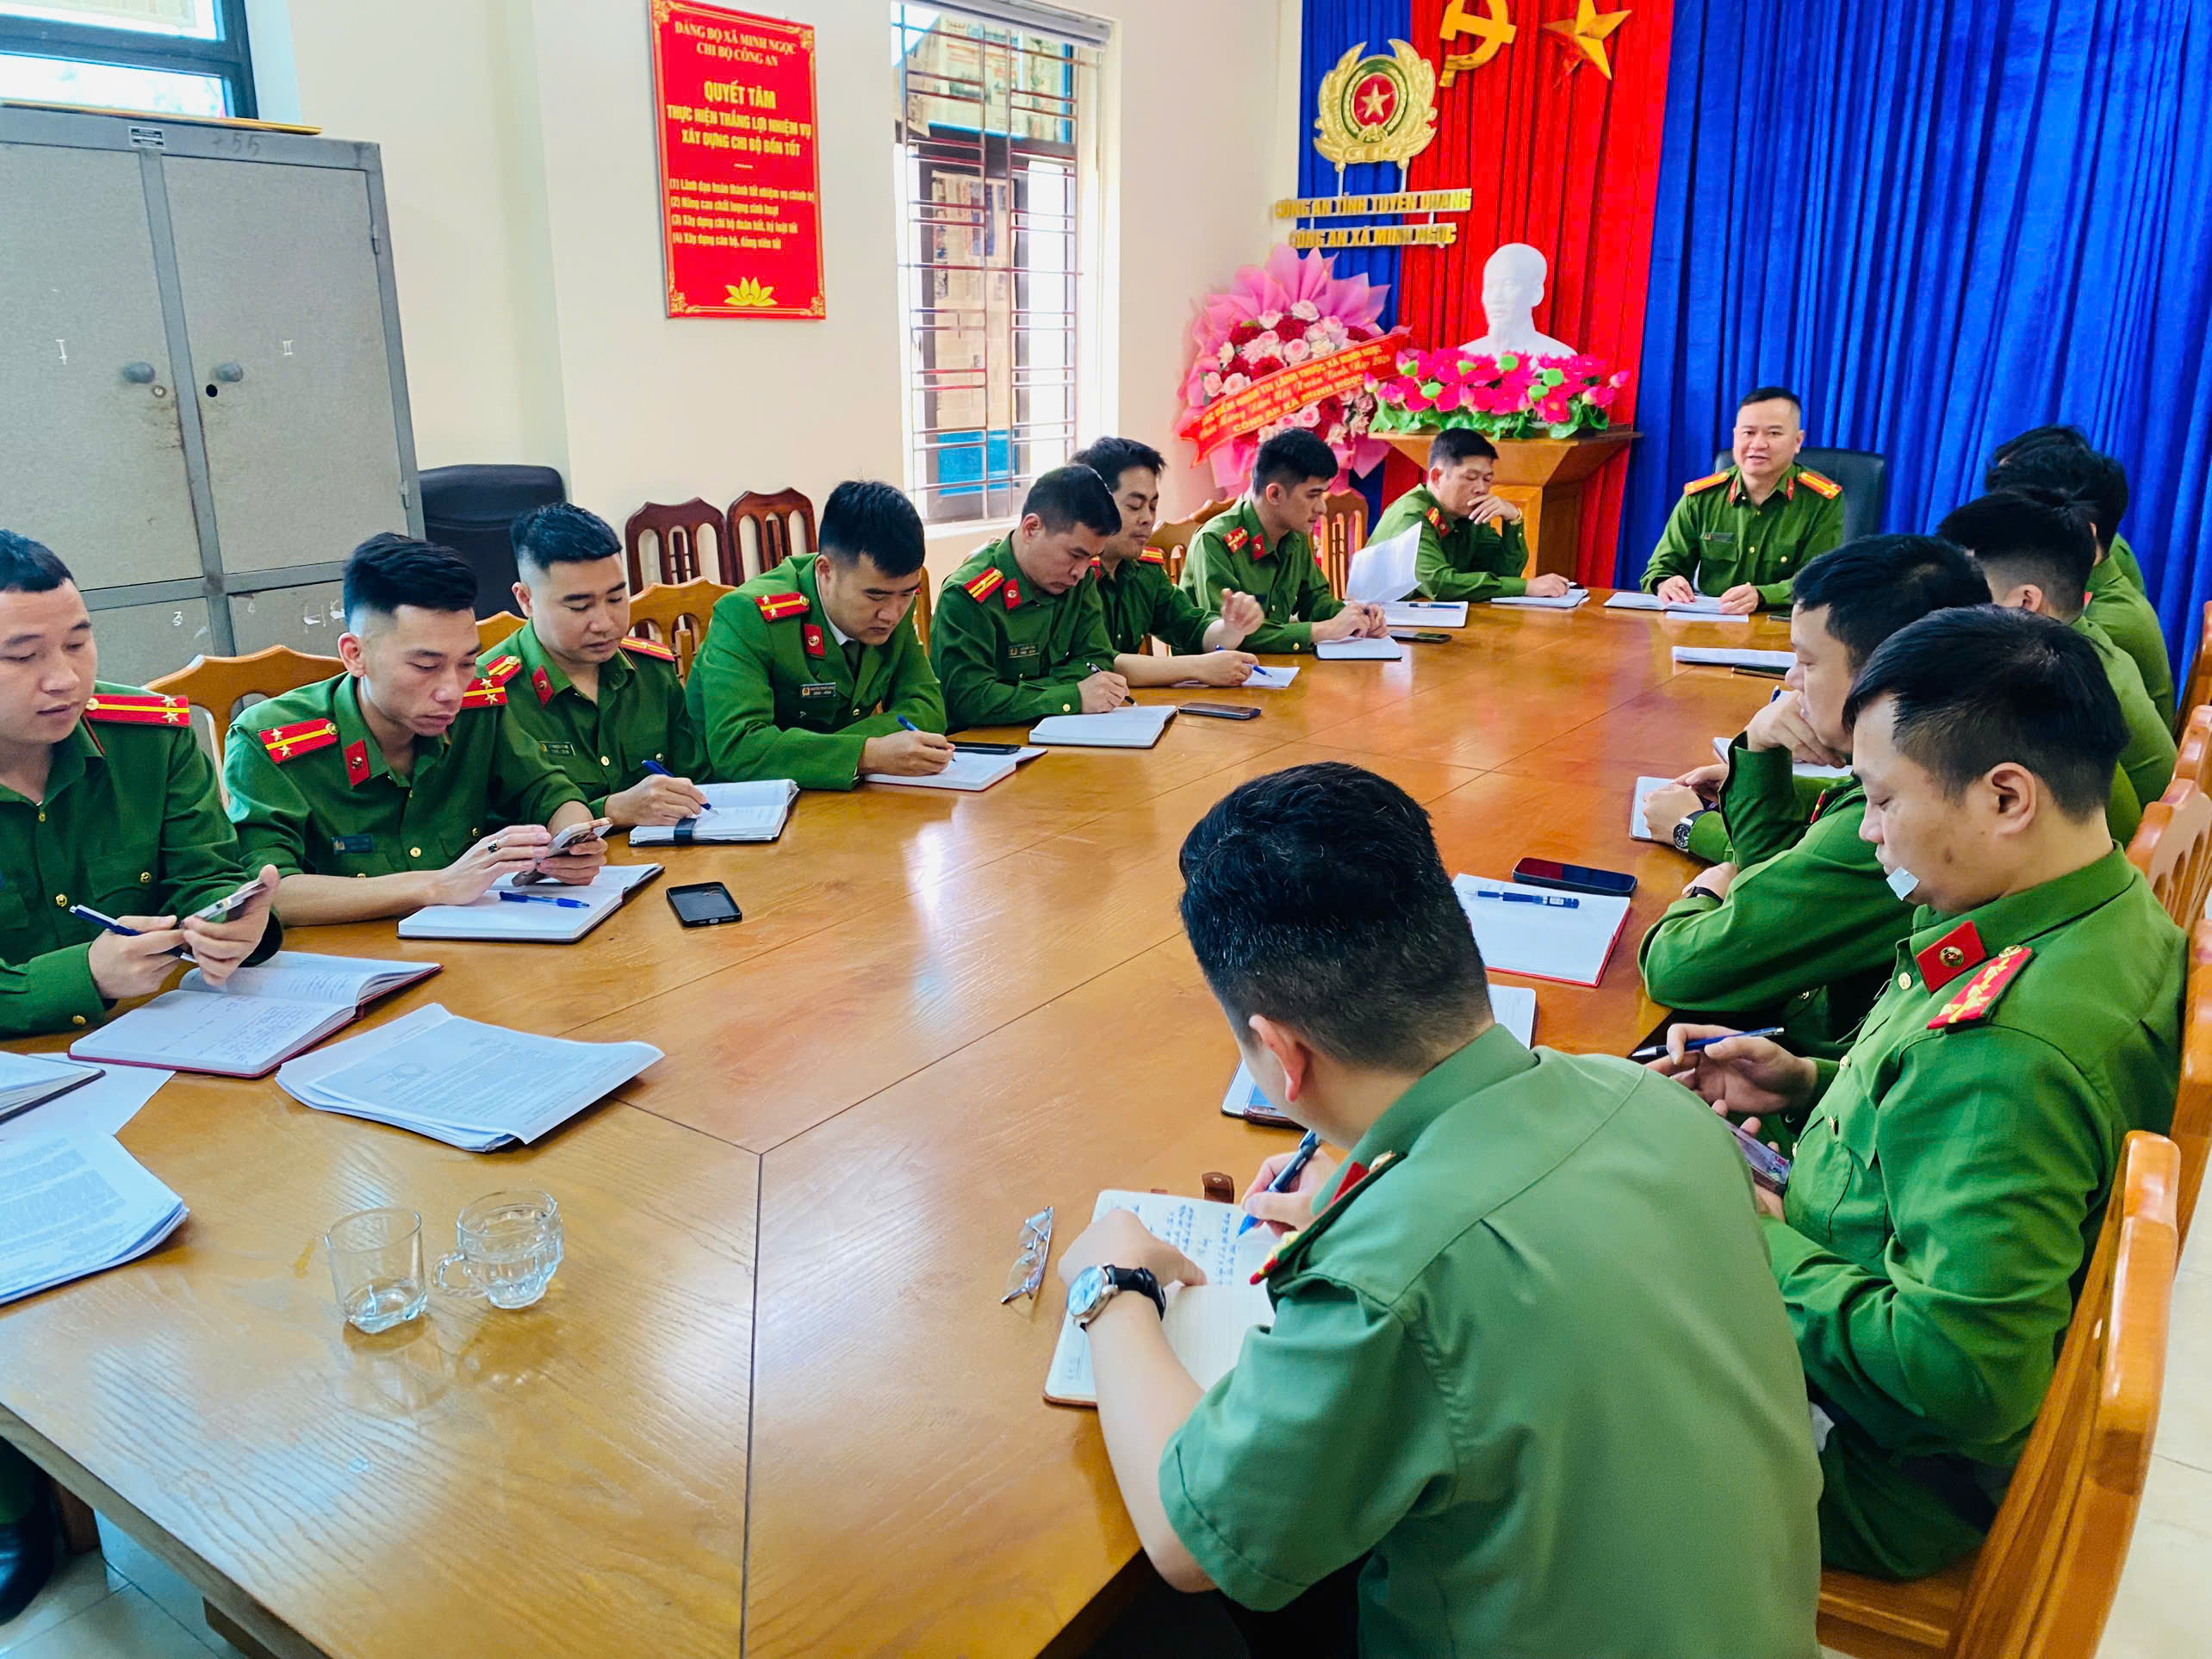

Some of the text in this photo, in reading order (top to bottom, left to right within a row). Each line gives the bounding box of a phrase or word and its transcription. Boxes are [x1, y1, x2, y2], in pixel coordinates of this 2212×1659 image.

[696, 41, 717, 55] CHI
[733, 47, 763, 65] CÔNG
[764, 54, 779, 66] AN
[739, 34, 767, 49] MINH
[768, 40, 795, 55] NGỌC
[704, 79, 777, 109] QUYẾT TÂM
[681, 127, 701, 145] XÂY
[730, 135, 748, 151] CHI
[1311, 198, 1333, 217] AN
[1328, 228, 1348, 247] AN
